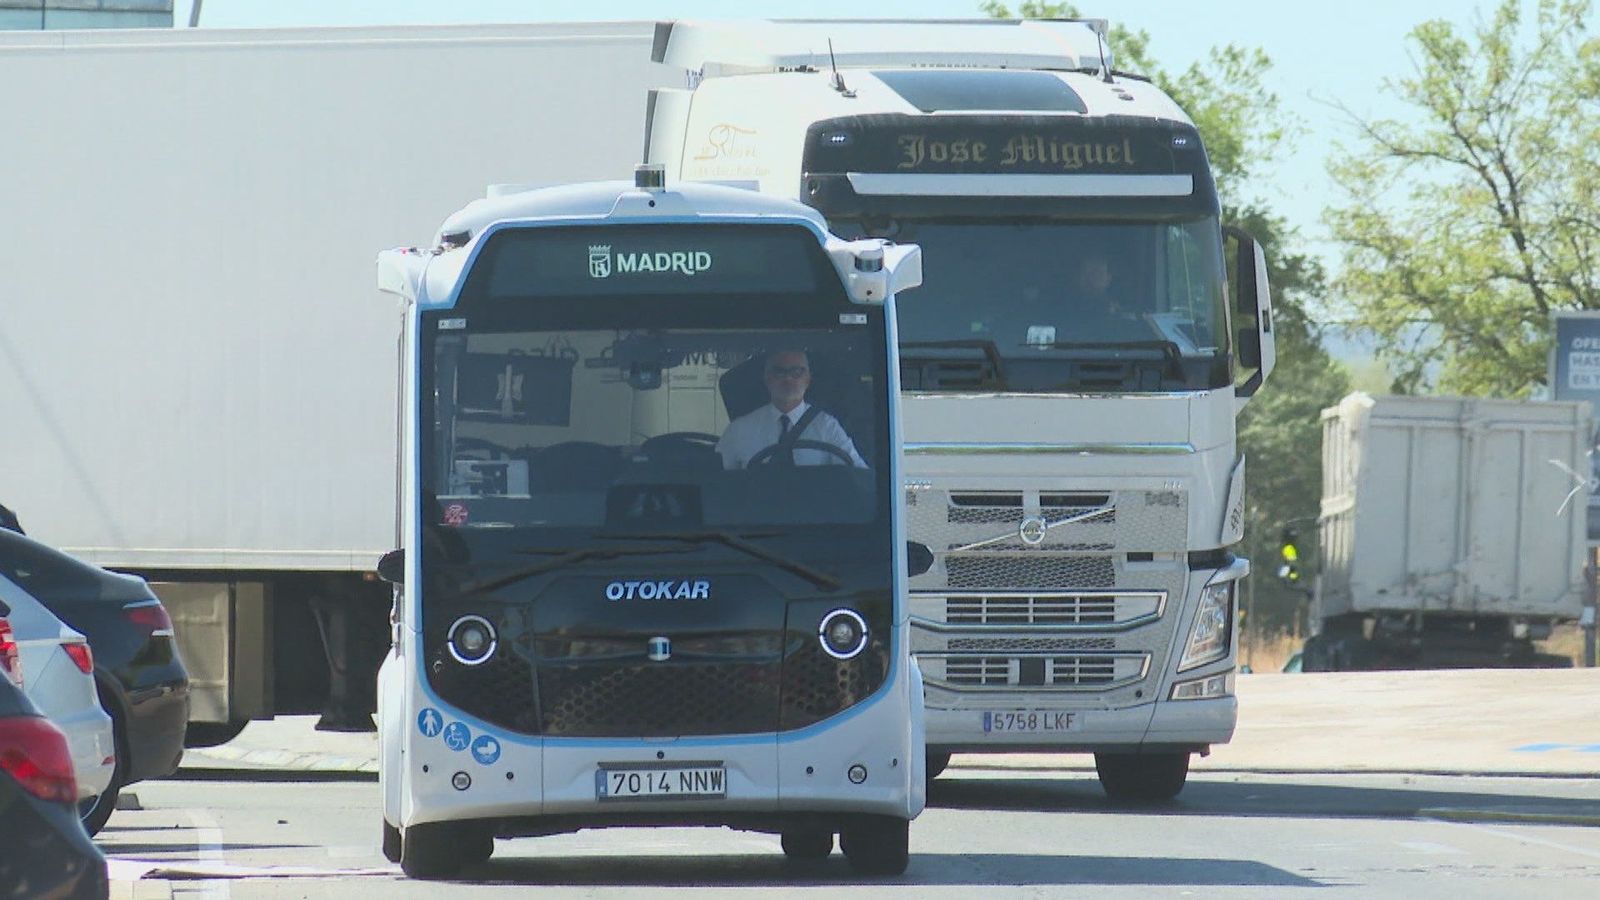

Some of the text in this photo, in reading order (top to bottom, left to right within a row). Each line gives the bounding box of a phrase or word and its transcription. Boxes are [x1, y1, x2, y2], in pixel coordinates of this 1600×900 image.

[898, 134, 1134, 169] Jose Miguel
[617, 251, 712, 275] MADRID
[606, 581, 710, 600] OTOKAR
[994, 713, 1075, 730] 5758 LKF
[613, 770, 722, 794] 7014 NNW
